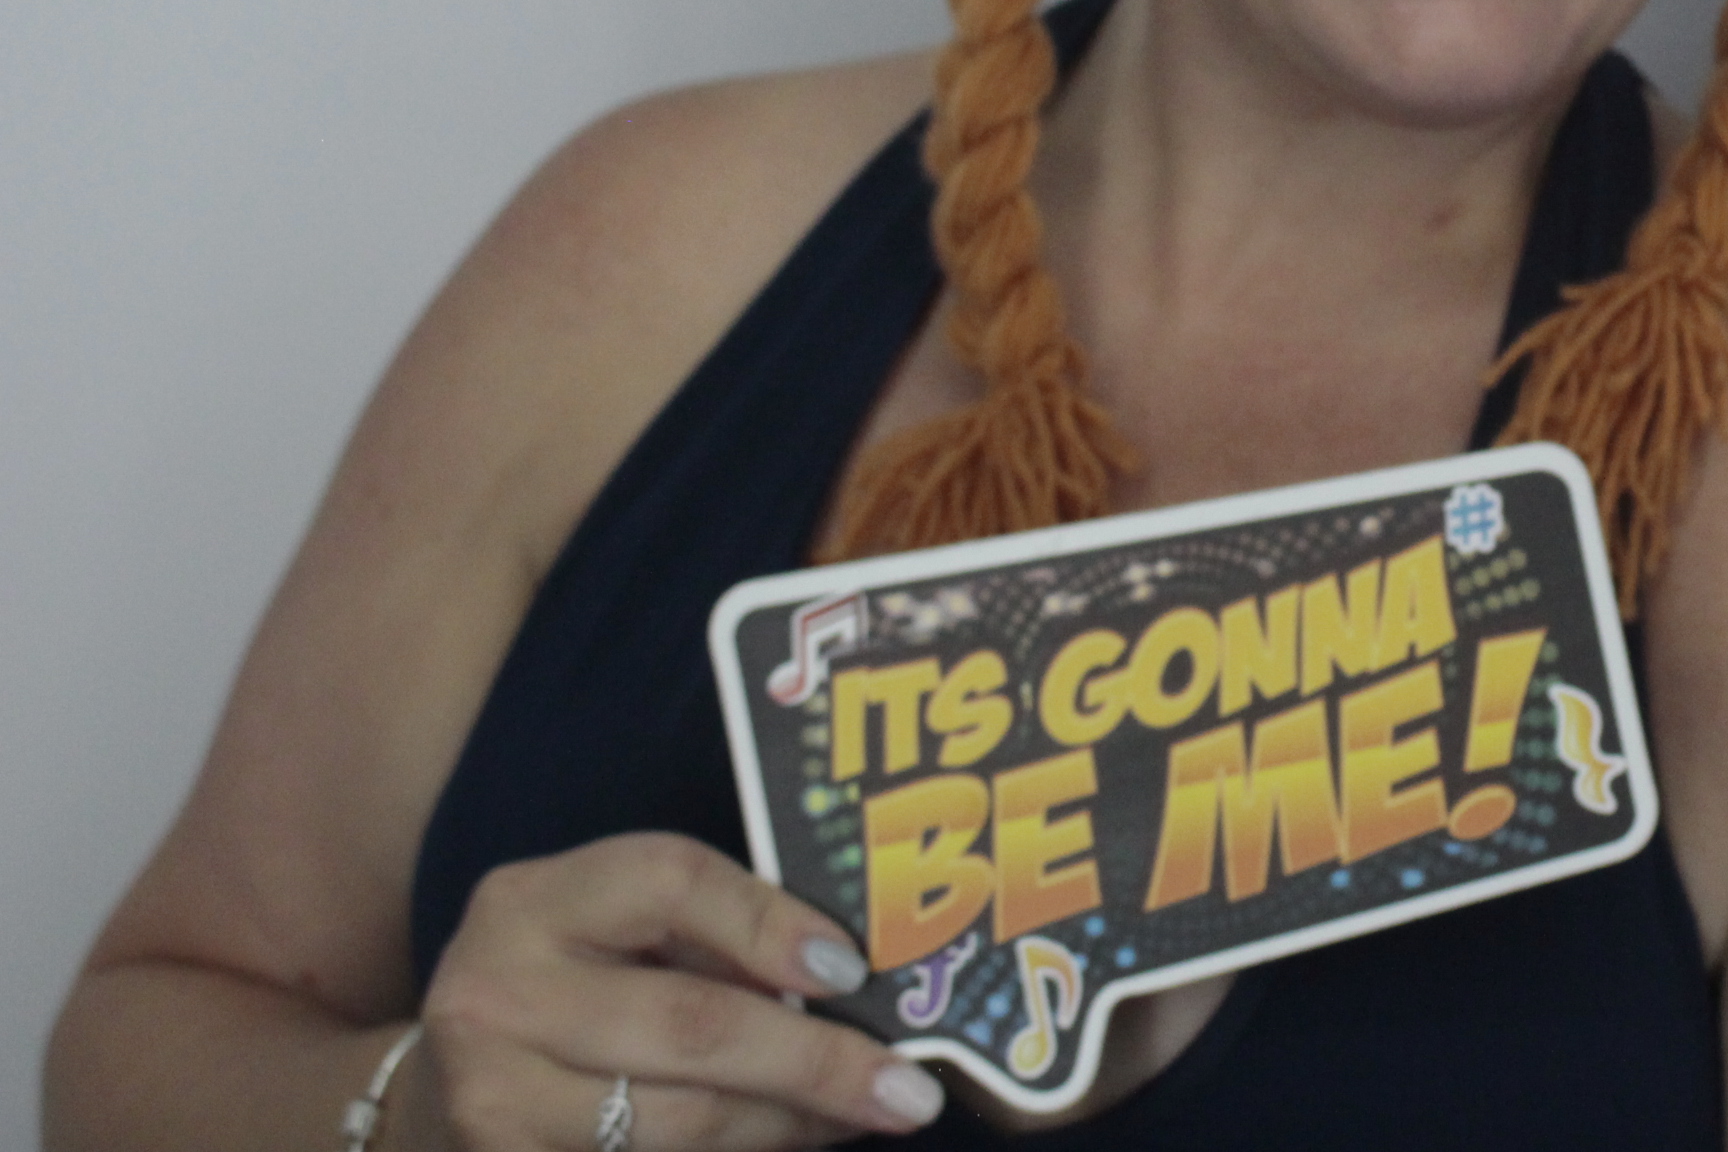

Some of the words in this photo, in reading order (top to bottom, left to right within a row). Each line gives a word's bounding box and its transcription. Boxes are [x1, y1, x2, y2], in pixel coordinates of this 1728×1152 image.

[1038, 535, 1456, 746] GONNA
[863, 748, 1101, 973] BE
[1144, 628, 1546, 912] ME!
